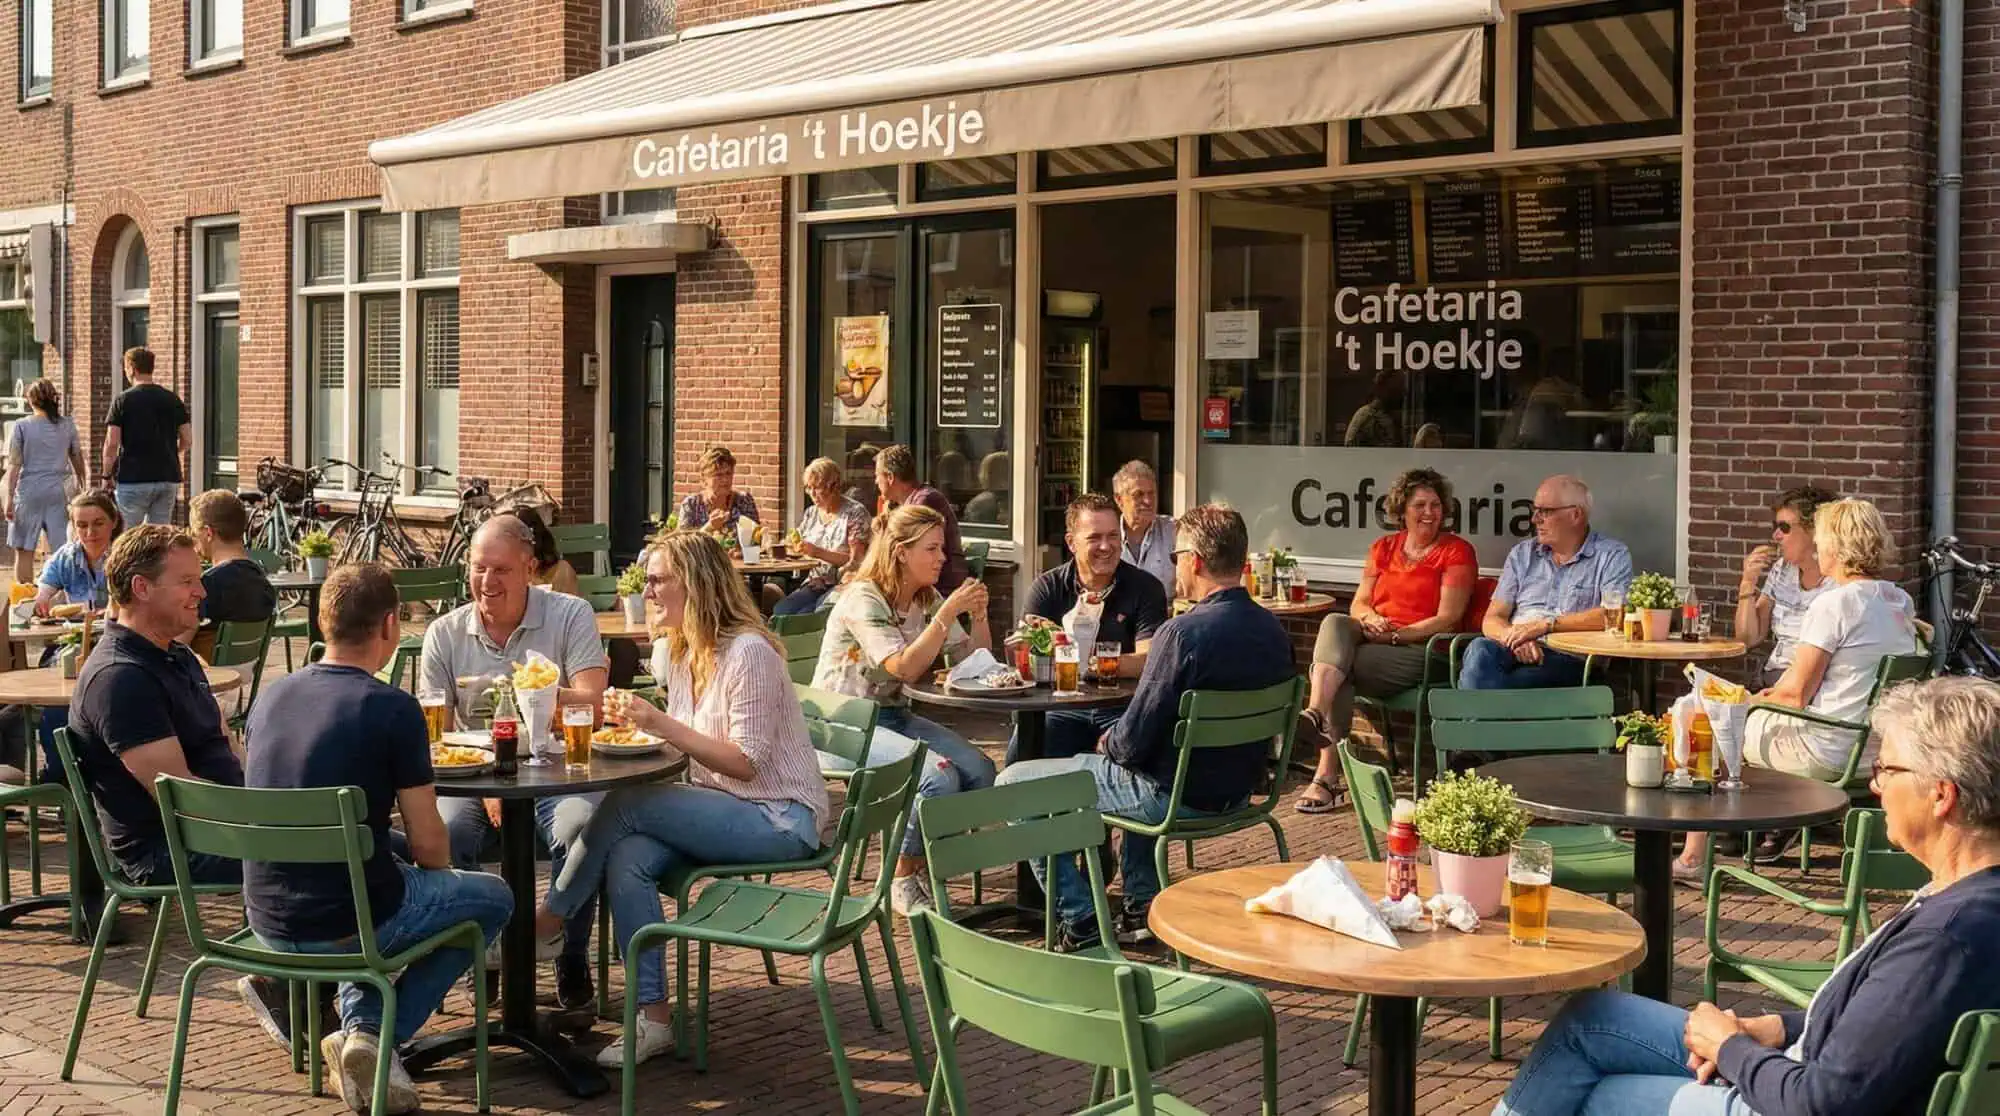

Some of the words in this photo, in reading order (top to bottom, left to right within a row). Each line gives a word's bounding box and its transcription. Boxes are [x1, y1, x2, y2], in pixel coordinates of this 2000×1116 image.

[633, 126, 788, 179] Cafetaria
[839, 101, 984, 157] Hoekje
[1334, 281, 1522, 324] Cafetaria
[1375, 329, 1522, 379] Hoekje
[1291, 478, 1535, 538] Cafearia
